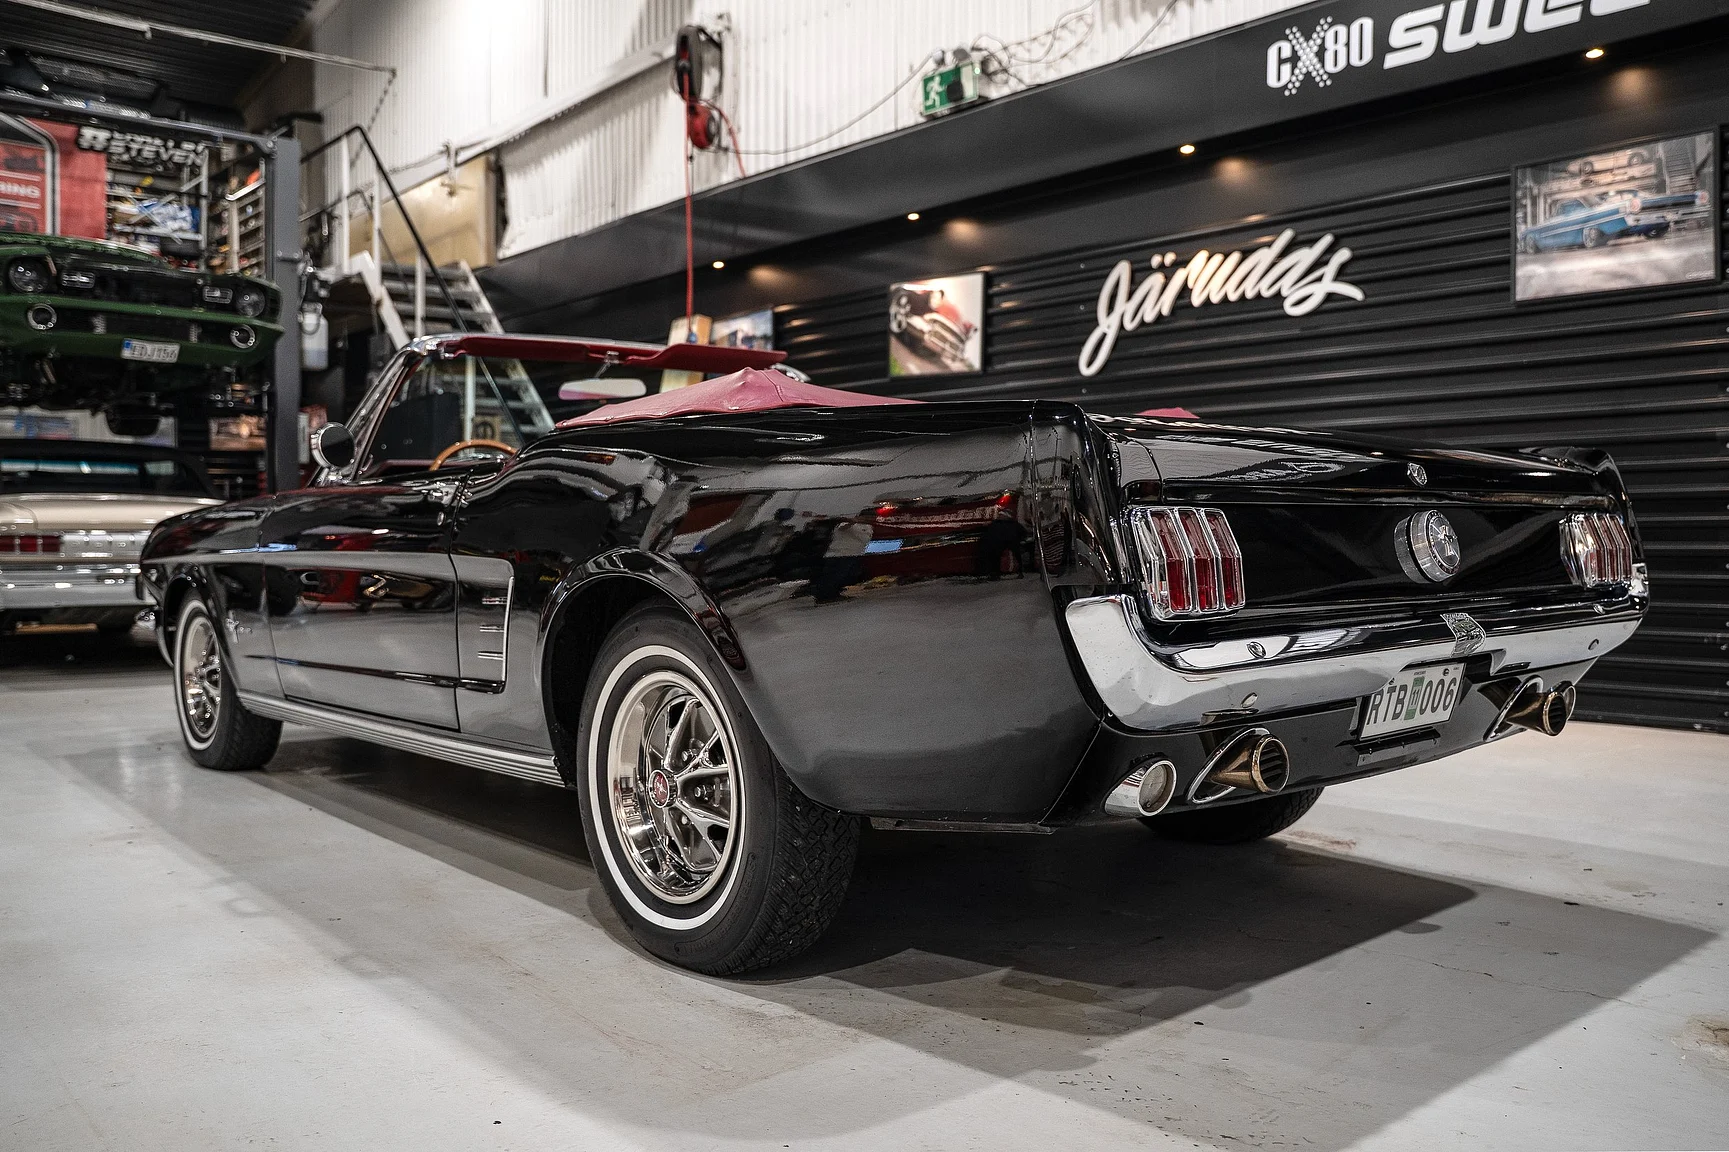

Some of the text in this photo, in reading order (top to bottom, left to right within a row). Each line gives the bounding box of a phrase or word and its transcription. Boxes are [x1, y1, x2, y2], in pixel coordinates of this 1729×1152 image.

[1267, 0, 1651, 96] CX80 SWE
[1366, 684, 1408, 725] RTB
[1419, 677, 1457, 715] 006
